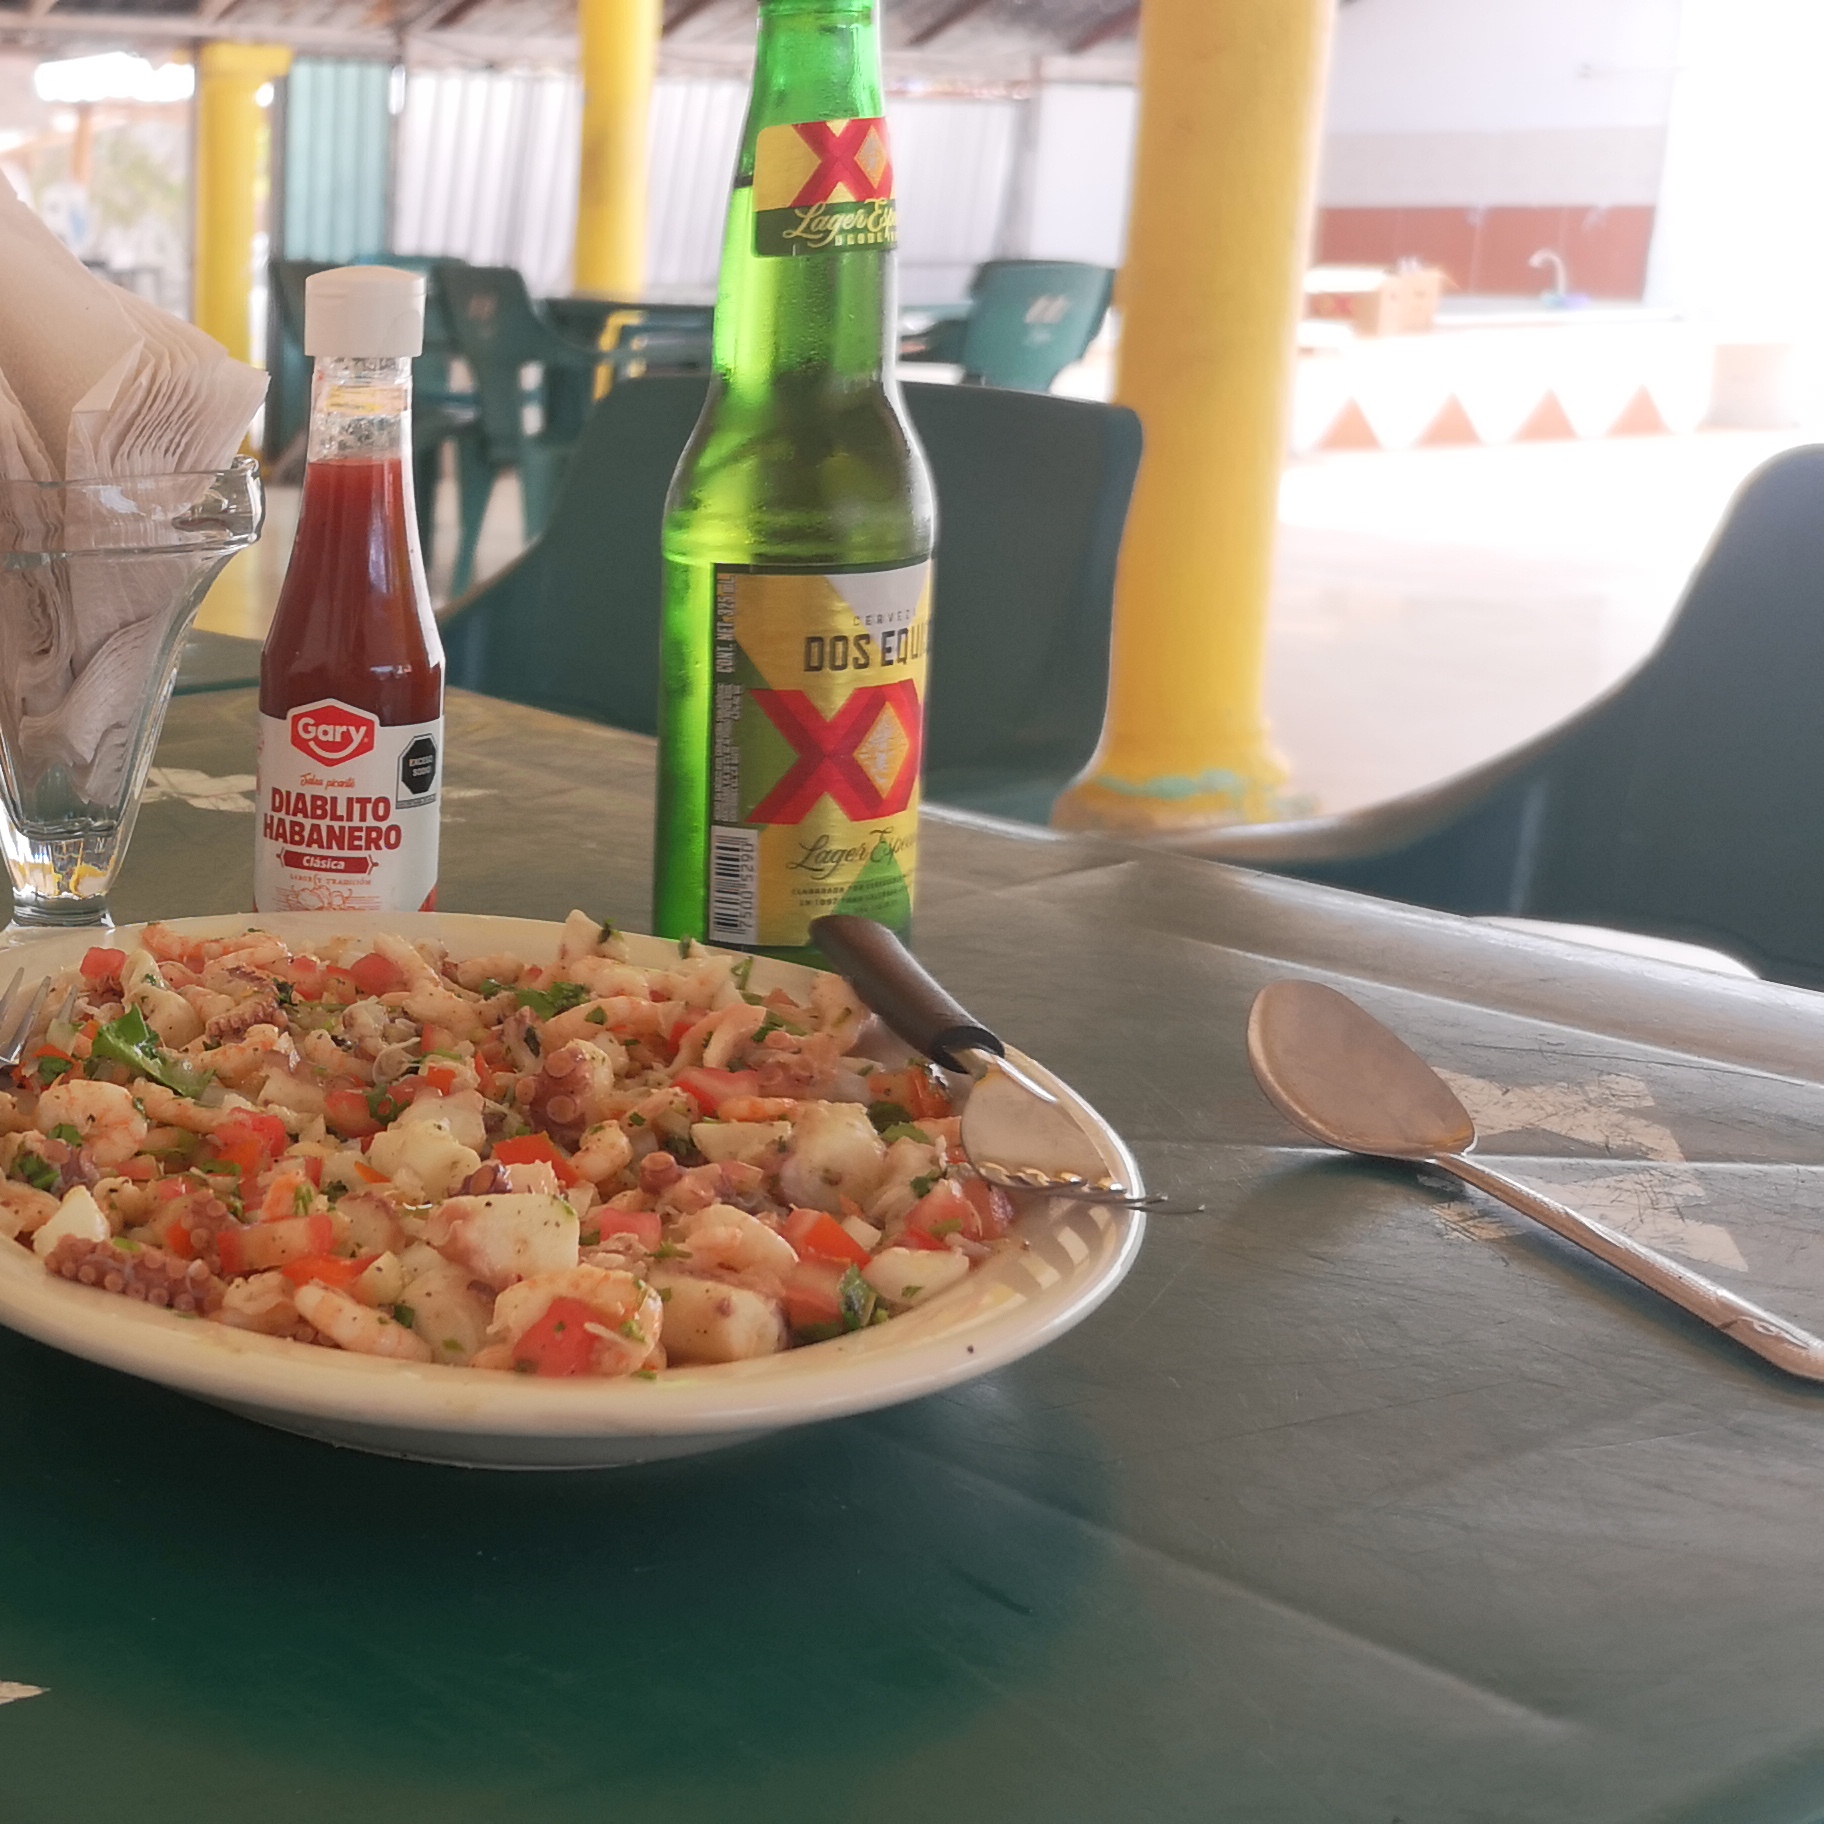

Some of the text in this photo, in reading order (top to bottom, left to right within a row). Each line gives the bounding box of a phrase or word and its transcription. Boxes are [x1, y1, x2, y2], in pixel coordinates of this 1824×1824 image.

[782, 202, 867, 248] Lager
[717, 596, 736, 616] 325
[852, 607, 917, 626] CERVEZ
[716, 621, 736, 641] NET
[803, 635, 871, 672] DOS
[297, 716, 368, 755] Gary
[271, 787, 392, 822] DIABLITO
[263, 813, 403, 851] HABANERO
[302, 855, 346, 870] Clásica
[785, 834, 870, 880] Lager
